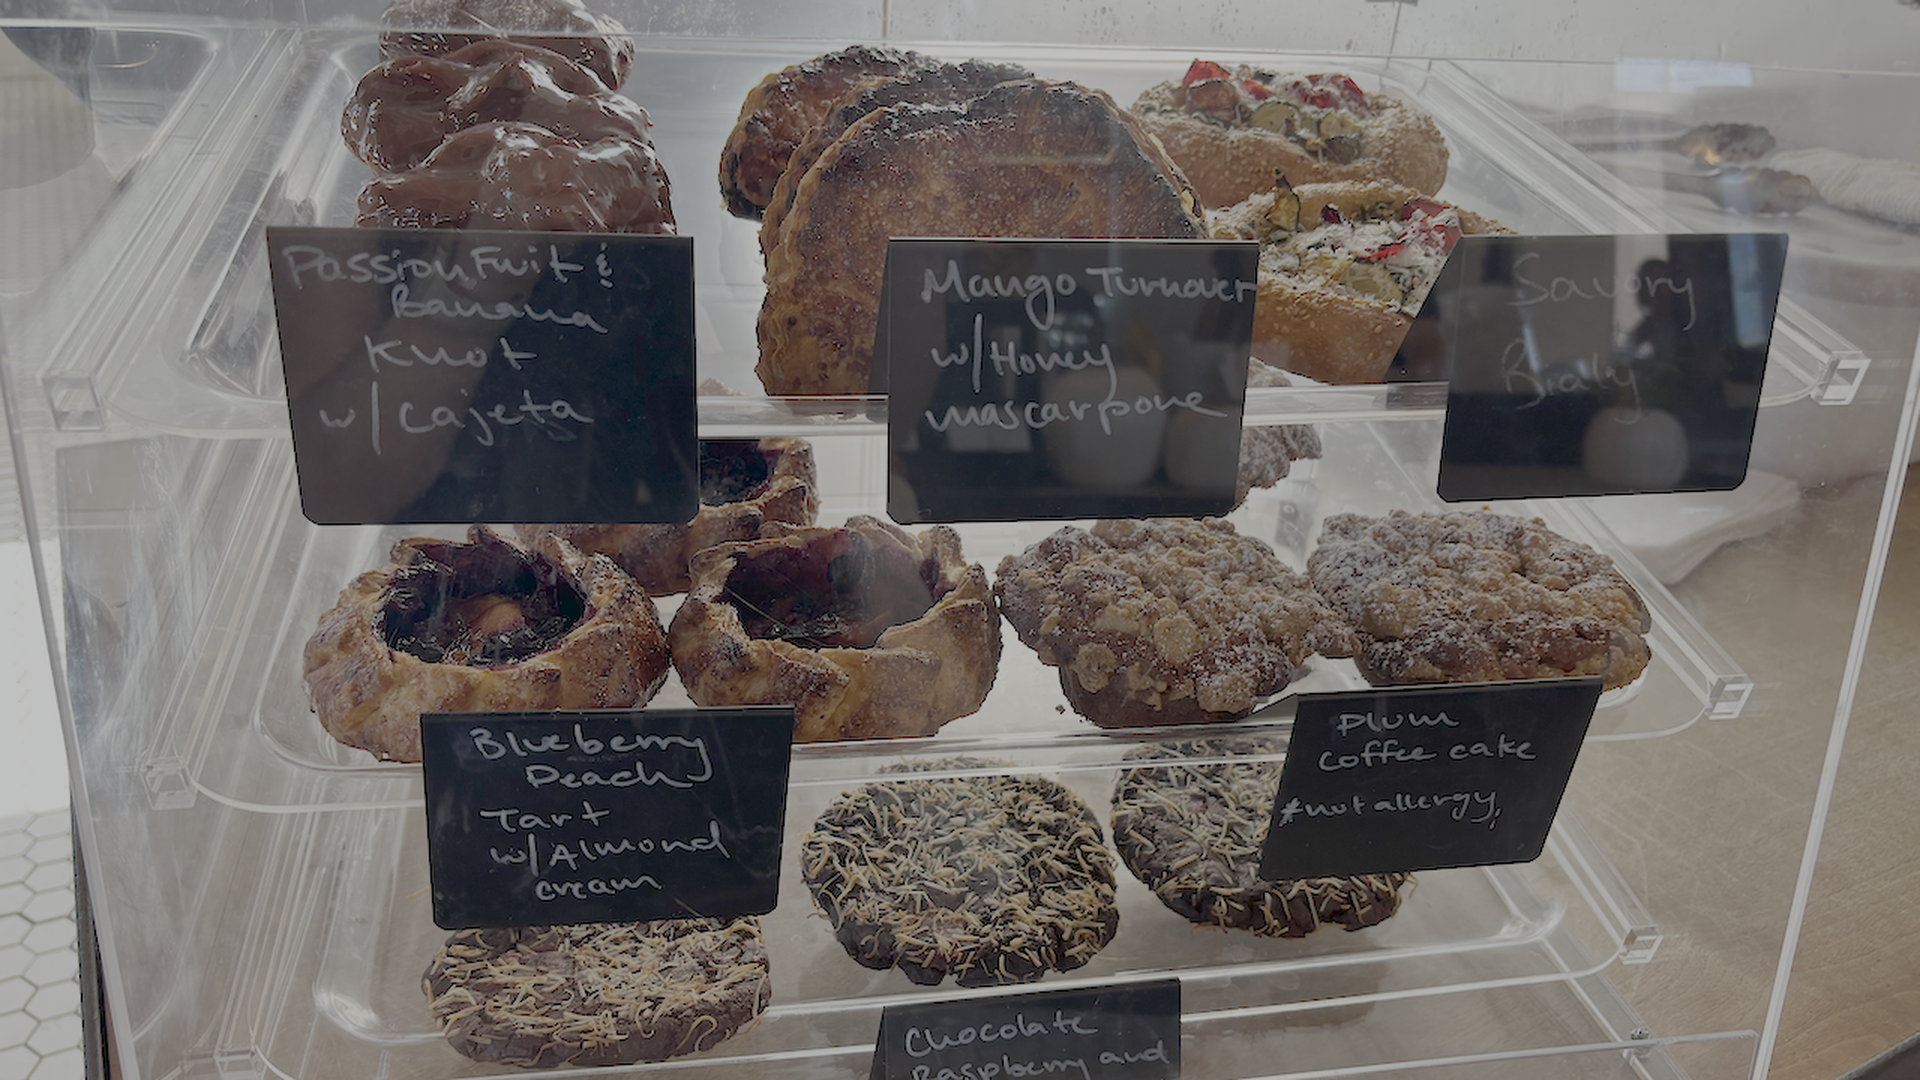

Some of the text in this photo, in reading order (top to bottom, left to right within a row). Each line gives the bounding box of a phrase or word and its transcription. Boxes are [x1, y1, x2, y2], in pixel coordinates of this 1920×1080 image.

[281, 244, 470, 290] Passion
[469, 245, 585, 284] Fruit
[391, 282, 609, 334] Banana
[920, 259, 1257, 331] Mango Turnover
[1507, 252, 1697, 332] Savory
[364, 335, 538, 373] Knot
[924, 391, 1229, 436] mascarpone
[469, 723, 714, 782] Blueberry
[1449, 733, 1537, 761] cake
[524, 761, 694, 789] Peach
[479, 800, 611, 833] Tart
[904, 1010, 1099, 1058] Chocolate
[1099, 1039, 1171, 1066] and
